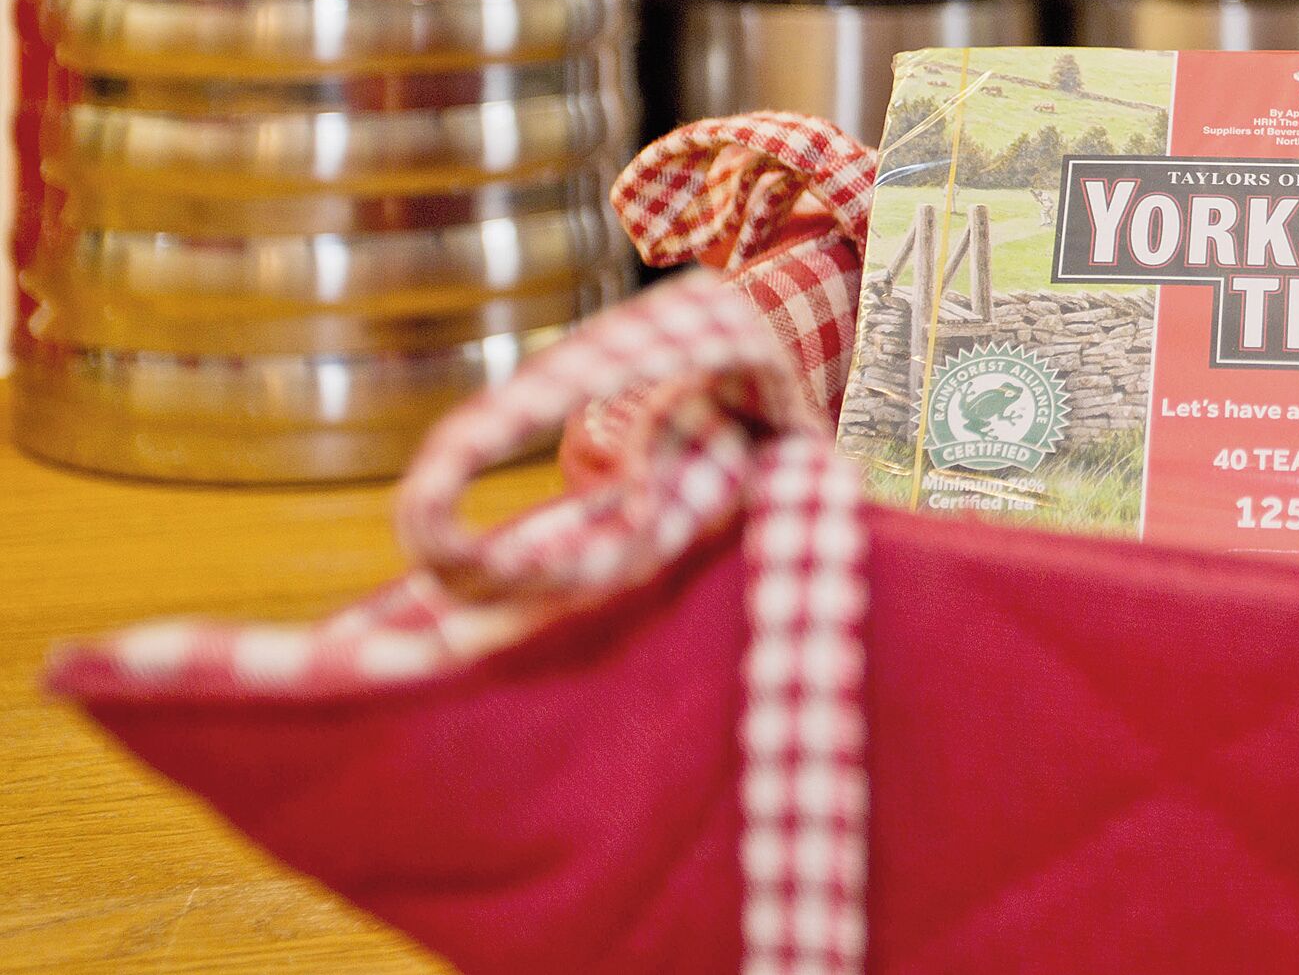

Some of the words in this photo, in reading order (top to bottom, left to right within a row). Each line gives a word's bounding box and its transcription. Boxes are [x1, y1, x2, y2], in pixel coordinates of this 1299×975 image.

[1253, 118, 1277, 126] HRH
[1280, 119, 1298, 127] The
[1269, 109, 1284, 119] By
[1203, 126, 1252, 137] Suppliers
[1254, 127, 1265, 136] of
[1167, 171, 1271, 187] TAYLORS
[933, 361, 1006, 422] RAINFOREST
[1009, 364, 1049, 425] ALLIANCE
[1161, 398, 1220, 418] Let's
[1225, 400, 1282, 419] have
[1287, 406, 1299, 420] a
[942, 442, 1030, 463] CERTIFIED
[1213, 448, 1247, 471] 40
[922, 475, 1003, 492] Minimum
[928, 493, 1003, 510] Certified
